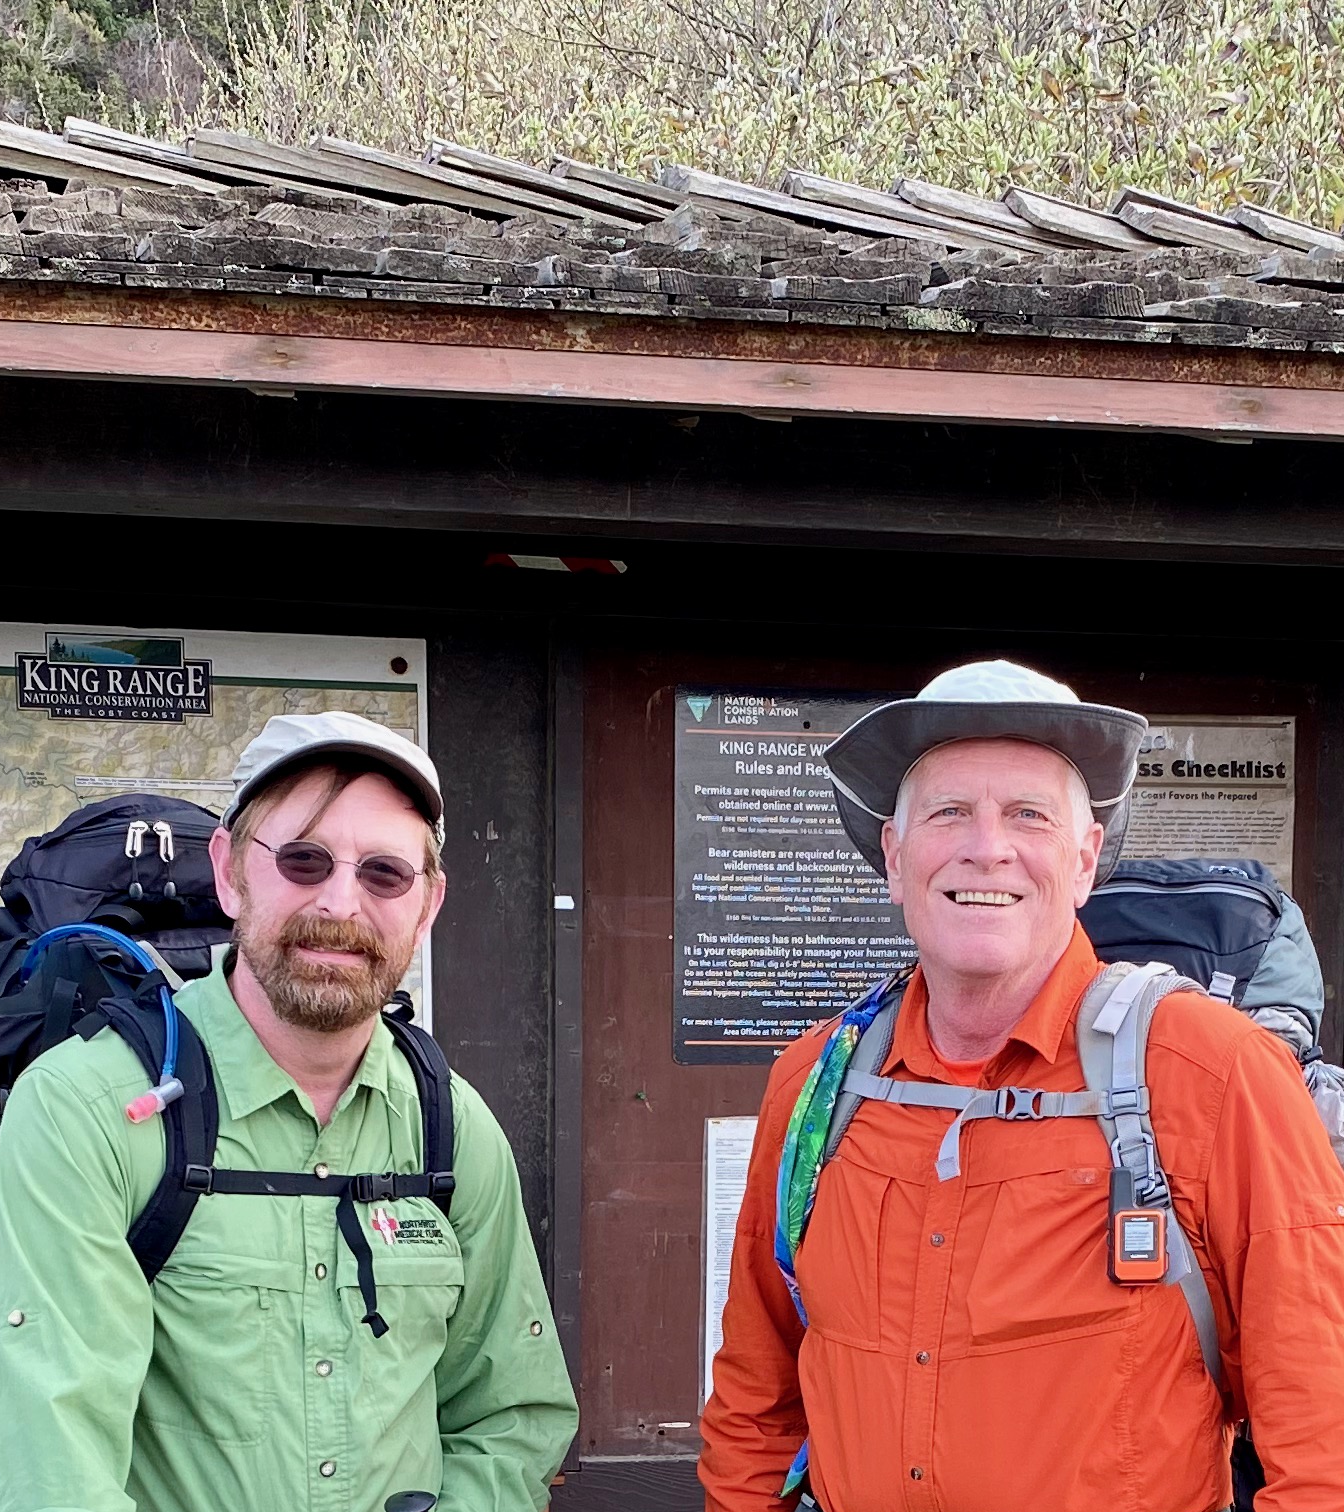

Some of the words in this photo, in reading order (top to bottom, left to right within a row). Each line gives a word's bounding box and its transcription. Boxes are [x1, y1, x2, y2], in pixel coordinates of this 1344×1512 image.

[23, 659, 100, 693] KING
[107, 665, 206, 697] RANGE
[23, 692, 82, 705] NATIONAL
[85, 694, 174, 709] CONSERVATION
[177, 698, 207, 710] AREA
[56, 708, 81, 716] THE
[89, 709, 123, 717] LOST
[132, 710, 176, 719] COAST
[724, 715, 758, 724] LANDS
[720, 741, 754, 756] KING
[758, 741, 806, 756] RANGE
[736, 760, 773, 775] Rules
[777, 762, 802, 775] and
[1171, 760, 1286, 779] Checklist
[694, 785, 732, 796] Permits
[734, 787, 750, 796] are
[752, 785, 790, 798] required
[792, 786, 806, 797] for
[1141, 791, 1166, 800] Coast
[1168, 791, 1198, 800] Favors
[1202, 791, 1215, 800] the
[1218, 792, 1258, 802] Prepared
[718, 800, 760, 811] obtained
[762, 800, 792, 811] online
[793, 802, 804, 811] at
[708, 848, 730, 858] Bear
[732, 848, 776, 858] canisters
[778, 850, 794, 858] are
[796, 849, 834, 861] required
[836, 849, 850, 860] for
[724, 860, 774, 870] wilderness
[776, 862, 794, 871] and
[796, 862, 854, 874] backcountry
[697, 933, 718, 944] This
[720, 933, 770, 944] wilderness
[772, 934, 790, 944] has
[792, 936, 804, 944] no
[806, 934, 856, 945] bathrooms
[858, 937, 868, 945] or
[684, 946, 691, 955] It
[693, 946, 702, 955] is
[704, 948, 724, 958] your
[726, 946, 790, 958] responsibility
[792, 948, 802, 956] to
[804, 949, 842, 958] manage
[844, 949, 864, 958] your
[866, 948, 898, 958] human
